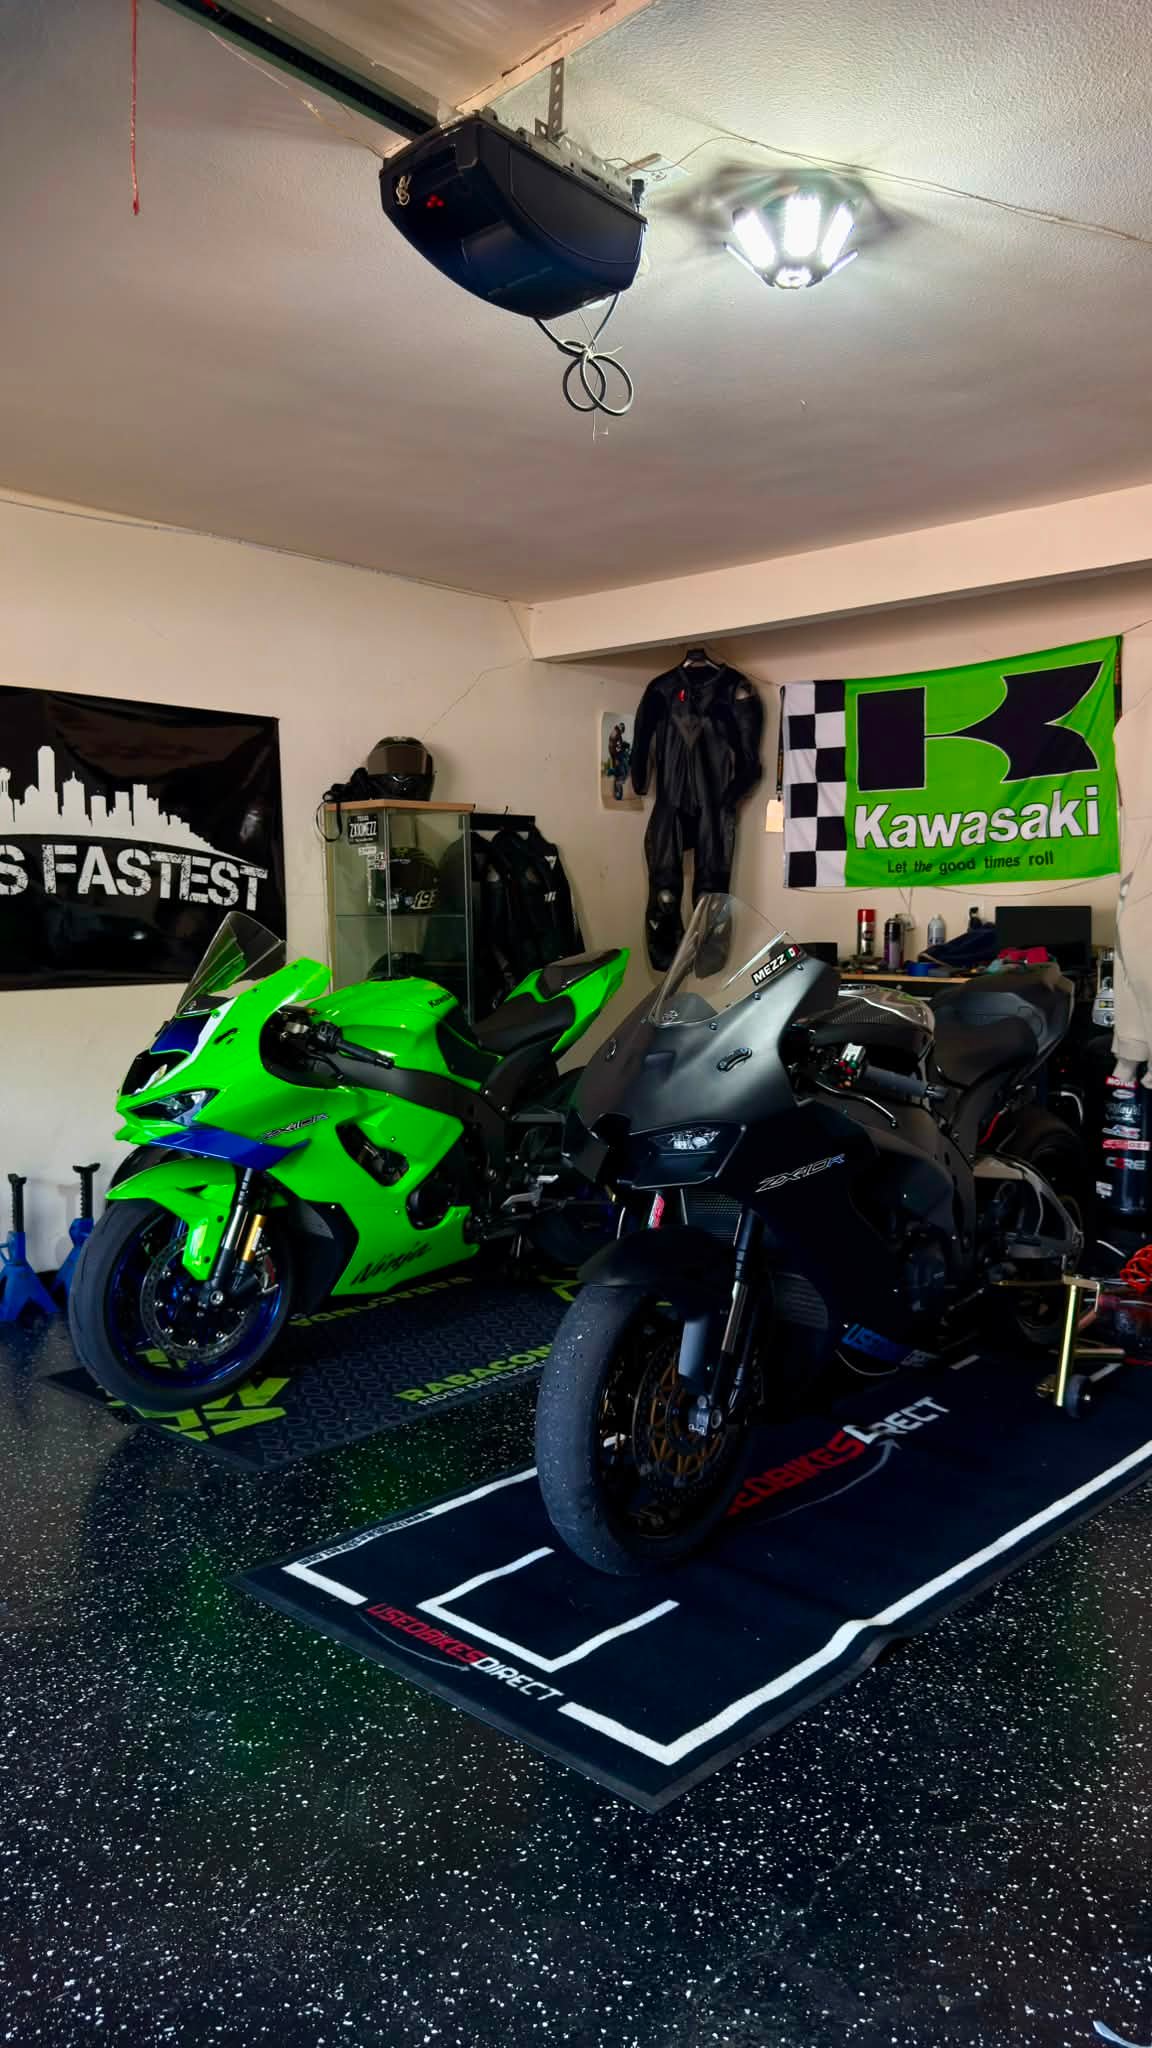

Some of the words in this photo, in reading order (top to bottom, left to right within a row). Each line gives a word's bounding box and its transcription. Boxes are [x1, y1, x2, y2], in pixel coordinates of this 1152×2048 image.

[854, 785, 1101, 850] Kawasaki
[41, 844, 269, 911] FASTEST
[887, 859, 907, 873] Let
[914, 860, 932, 873] the
[939, 858, 976, 875] good
[984, 855, 1021, 869] times
[1028, 851, 1054, 867] roll
[752, 953, 787, 984] MEZZ
[350, 1241, 432, 1287] Ninja
[417, 1387, 466, 1407] RIDER
